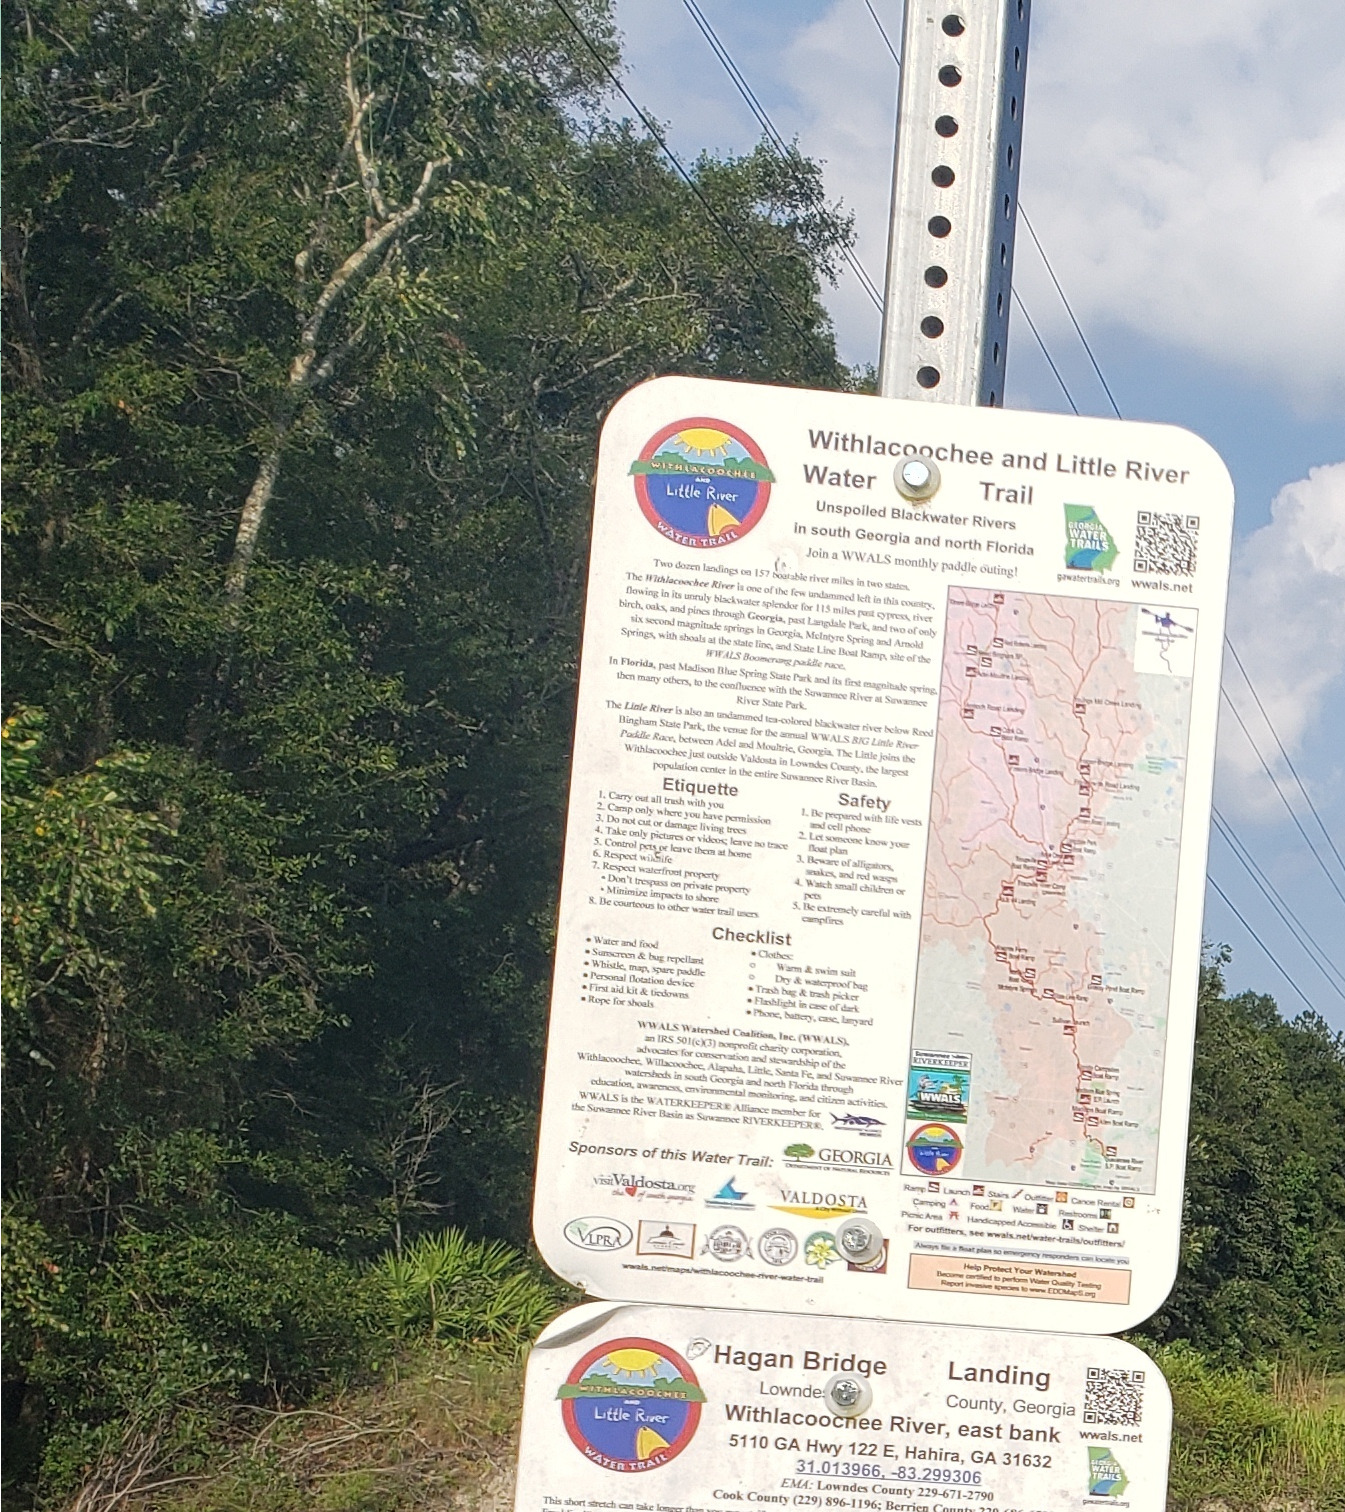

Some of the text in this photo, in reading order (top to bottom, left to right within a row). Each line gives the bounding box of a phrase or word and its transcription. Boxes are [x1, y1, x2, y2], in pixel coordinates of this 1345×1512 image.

[808, 429, 1190, 484] Withlacoochee and Little River
[650, 460, 756, 479] WITHLACOOCHEE
[666, 483, 739, 502] Little River
[803, 464, 1033, 505] Water Trail
[816, 500, 1016, 530] Unspoiled Blackwater Rivers
[656, 522, 737, 548] WATER TRAIL
[794, 522, 1034, 556] in south Georgia and north Florida
[1069, 529, 1108, 541] WATER
[1069, 538, 1109, 551] TRAILS
[806, 547, 1018, 579] Join a WWALS monthly paddle outing!
[1131, 580, 1193, 593] wwals.net
[663, 777, 738, 797] Etiquette
[599, 790, 724, 810] 1. Carry out all trash with you
[838, 793, 891, 813] Safety
[801, 808, 922, 826] 1. Be prepared with life vests
[810, 821, 871, 834] and cell phone
[594, 936, 659, 949] Water and food
[712, 927, 792, 946] Checklist
[590, 971, 695, 988] Personal flotation device
[912, 1056, 969, 1067] RIVERKEEPER
[919, 1091, 961, 1104] WWALS
[569, 1141, 774, 1168] Sponsors of this Water Trail:
[818, 1148, 893, 1166] GEORGIA
[780, 1189, 867, 1208] VALDOSTA
[963, 1263, 1077, 1278] Help Protect Your Watershed
[714, 1344, 1050, 1392] Hagan Bridge Landing
[578, 1384, 687, 1398] WITHLACOOCHEE
[594, 1406, 670, 1425] Little River
[946, 1394, 1007, 1415] County,
[1013, 1399, 1076, 1419] Georgia
[890, 1416, 950, 1439] River,
[958, 1424, 1003, 1439] east
[1009, 1424, 1060, 1443] bank
[1079, 1431, 1143, 1443] wwals.net
[584, 1447, 667, 1472] WATER TRAIL
[729, 1434, 1052, 1468] 5110 GA Hwy 122 E, Hahira, GA 31632
[795, 1459, 982, 1483] 31.013966, -83.299306
[1092, 1464, 1120, 1473] WATER
[1092, 1472, 1121, 1480] TRAILS
[781, 1478, 994, 1501] EMA: Lowndes County 229-671-2790
[713, 1489, 744, 1501] Cook
[747, 1491, 790, 1506] County
[793, 1495, 822, 1507] (229)
[825, 1496, 882, 1511] 896-1196;
[885, 1500, 929, 1512] Berrien
